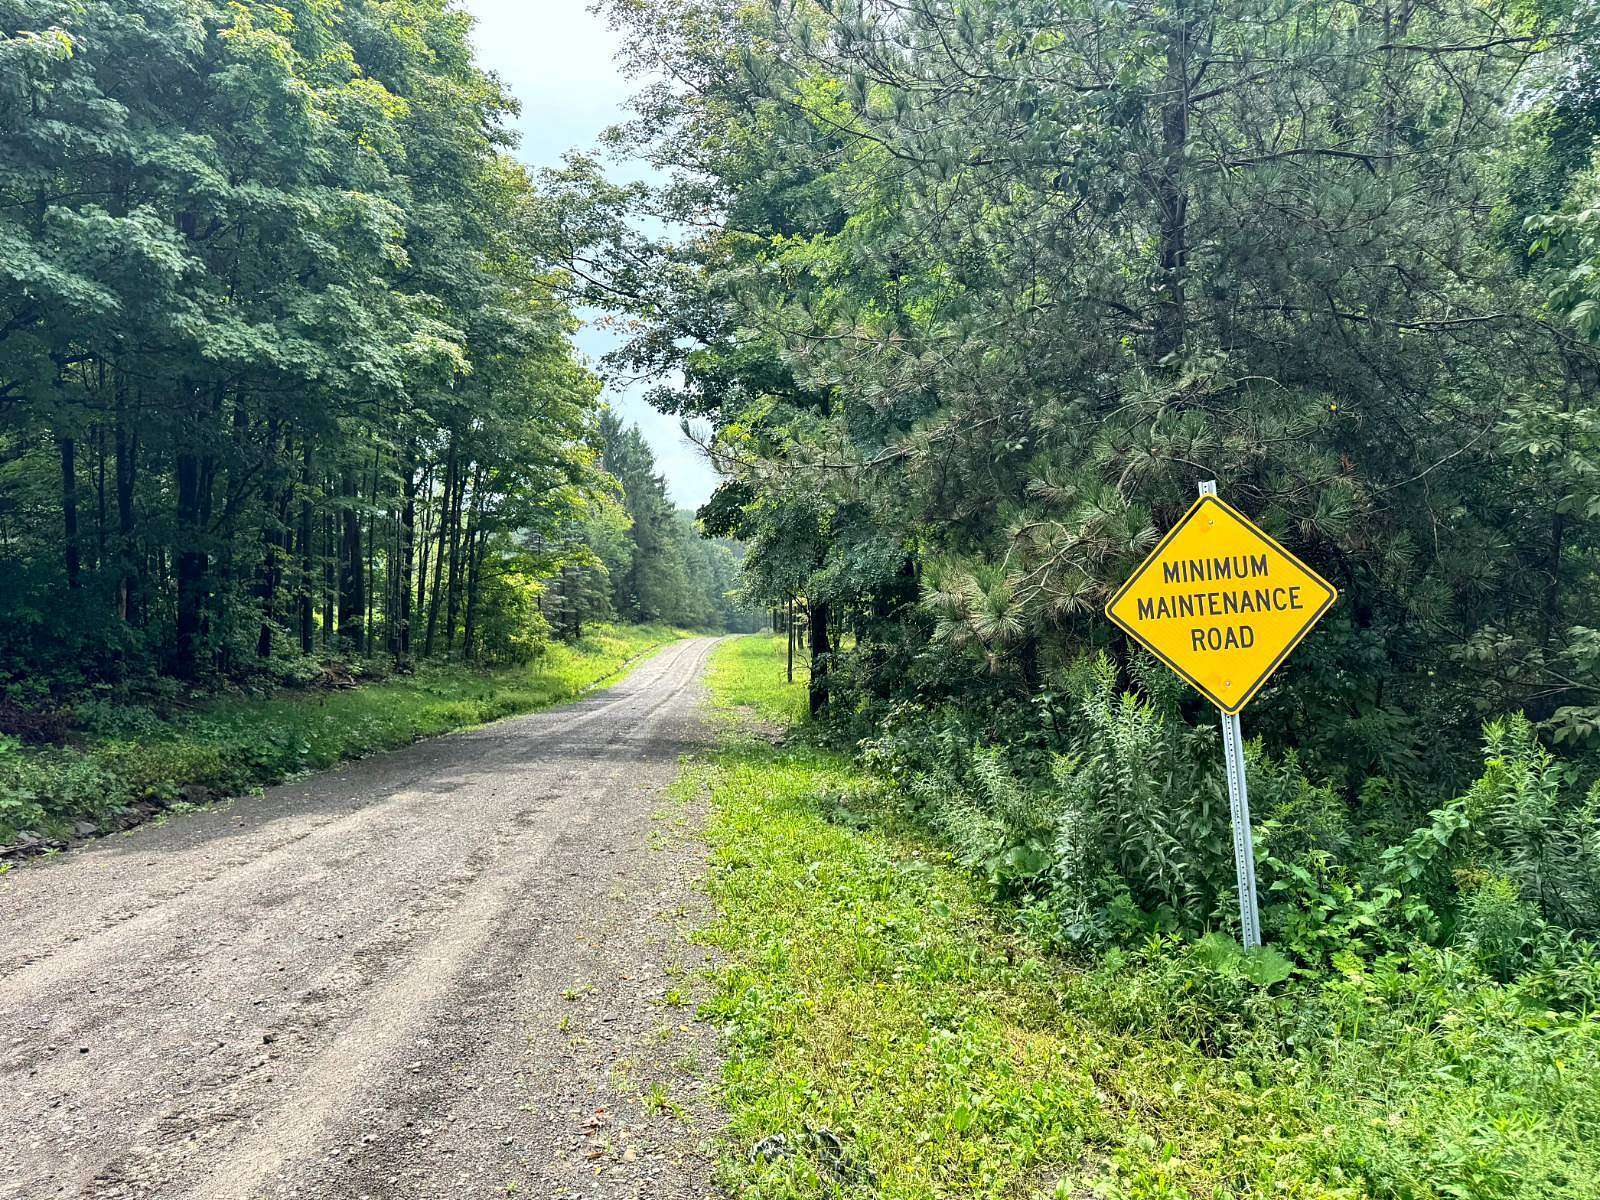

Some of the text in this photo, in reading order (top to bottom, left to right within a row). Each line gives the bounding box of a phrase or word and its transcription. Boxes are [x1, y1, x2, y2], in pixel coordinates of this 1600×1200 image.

[1162, 554, 1269, 584] MINIMUM
[1137, 586, 1304, 621] MAINTENANCE
[1190, 625, 1255, 652] ROAD
